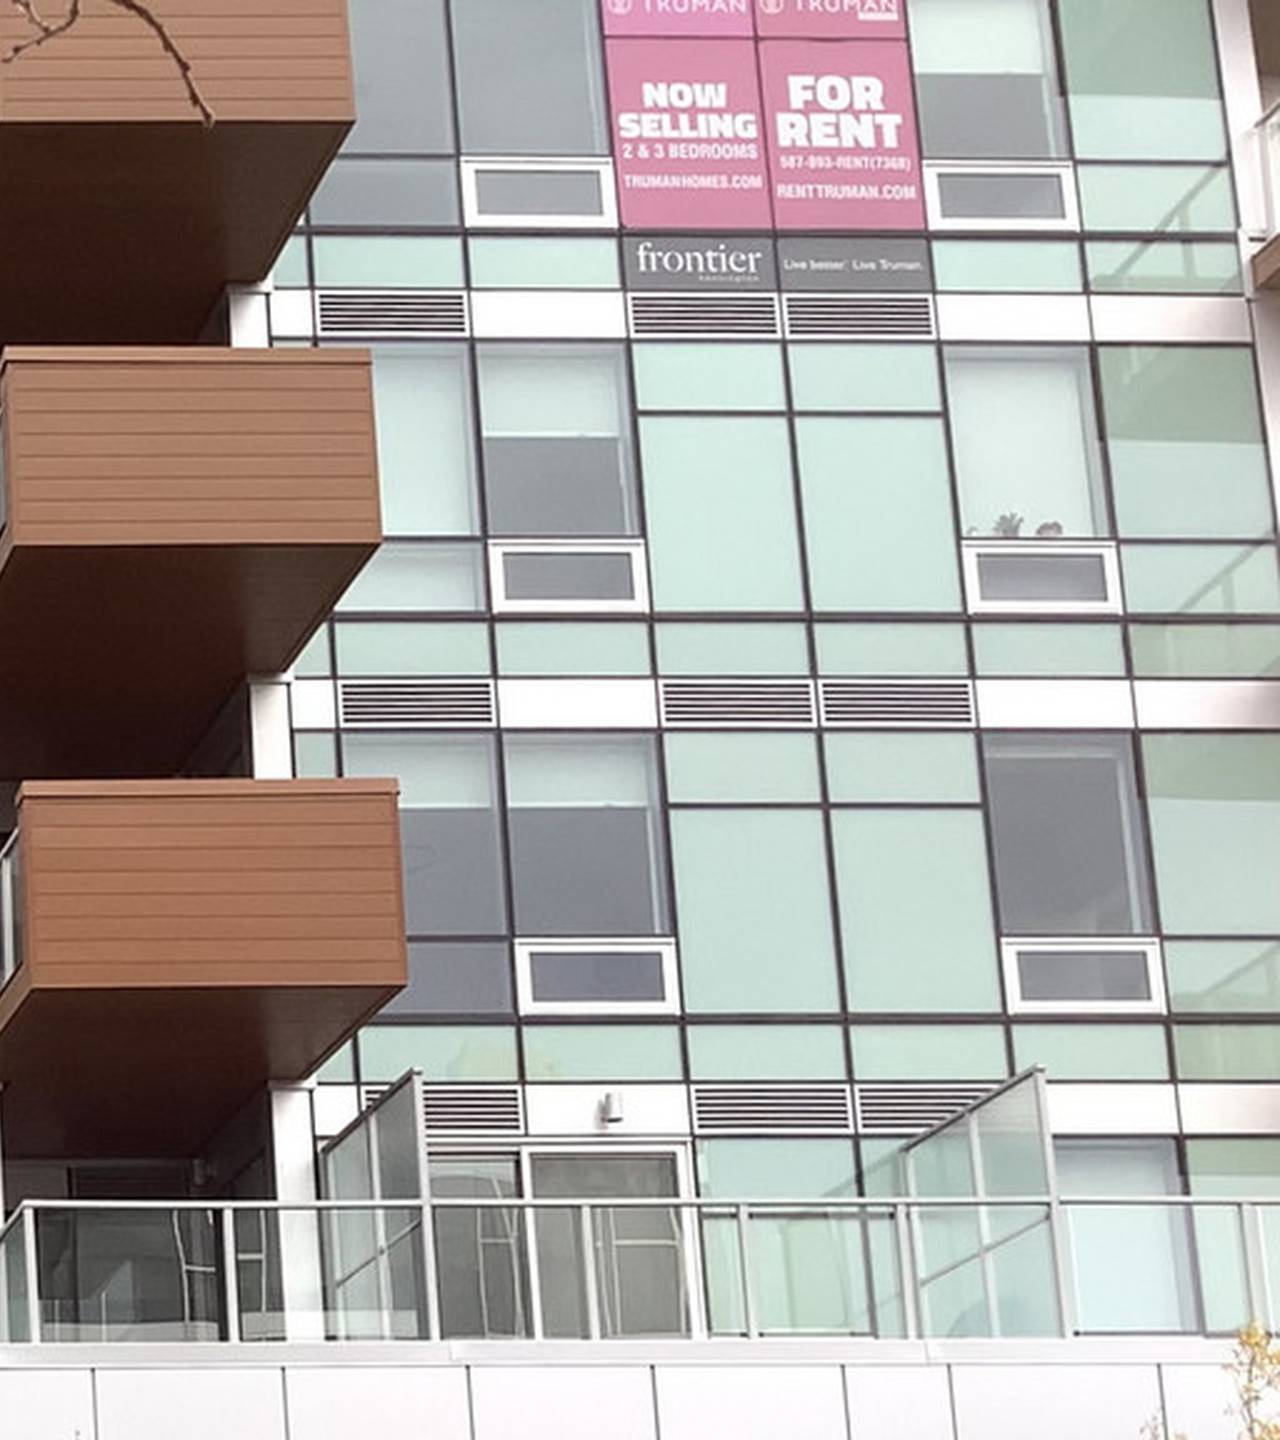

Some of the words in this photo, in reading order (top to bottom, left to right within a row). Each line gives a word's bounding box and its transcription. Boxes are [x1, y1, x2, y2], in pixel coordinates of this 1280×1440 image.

[642, 82, 727, 108] NOW
[787, 75, 885, 110] FOR
[618, 113, 757, 138] SELLING
[776, 113, 902, 148] RENT
[622, 143, 633, 158] 2
[637, 144, 650, 158] &
[653, 144, 665, 158] 3
[668, 144, 758, 160] BEDROOMS
[624, 174, 763, 189] TRUMANHOMES.COM
[777, 184, 916, 200] RENTTRUMAN.COM
[637, 241, 762, 273] frontier
[852, 259, 876, 271] Live
